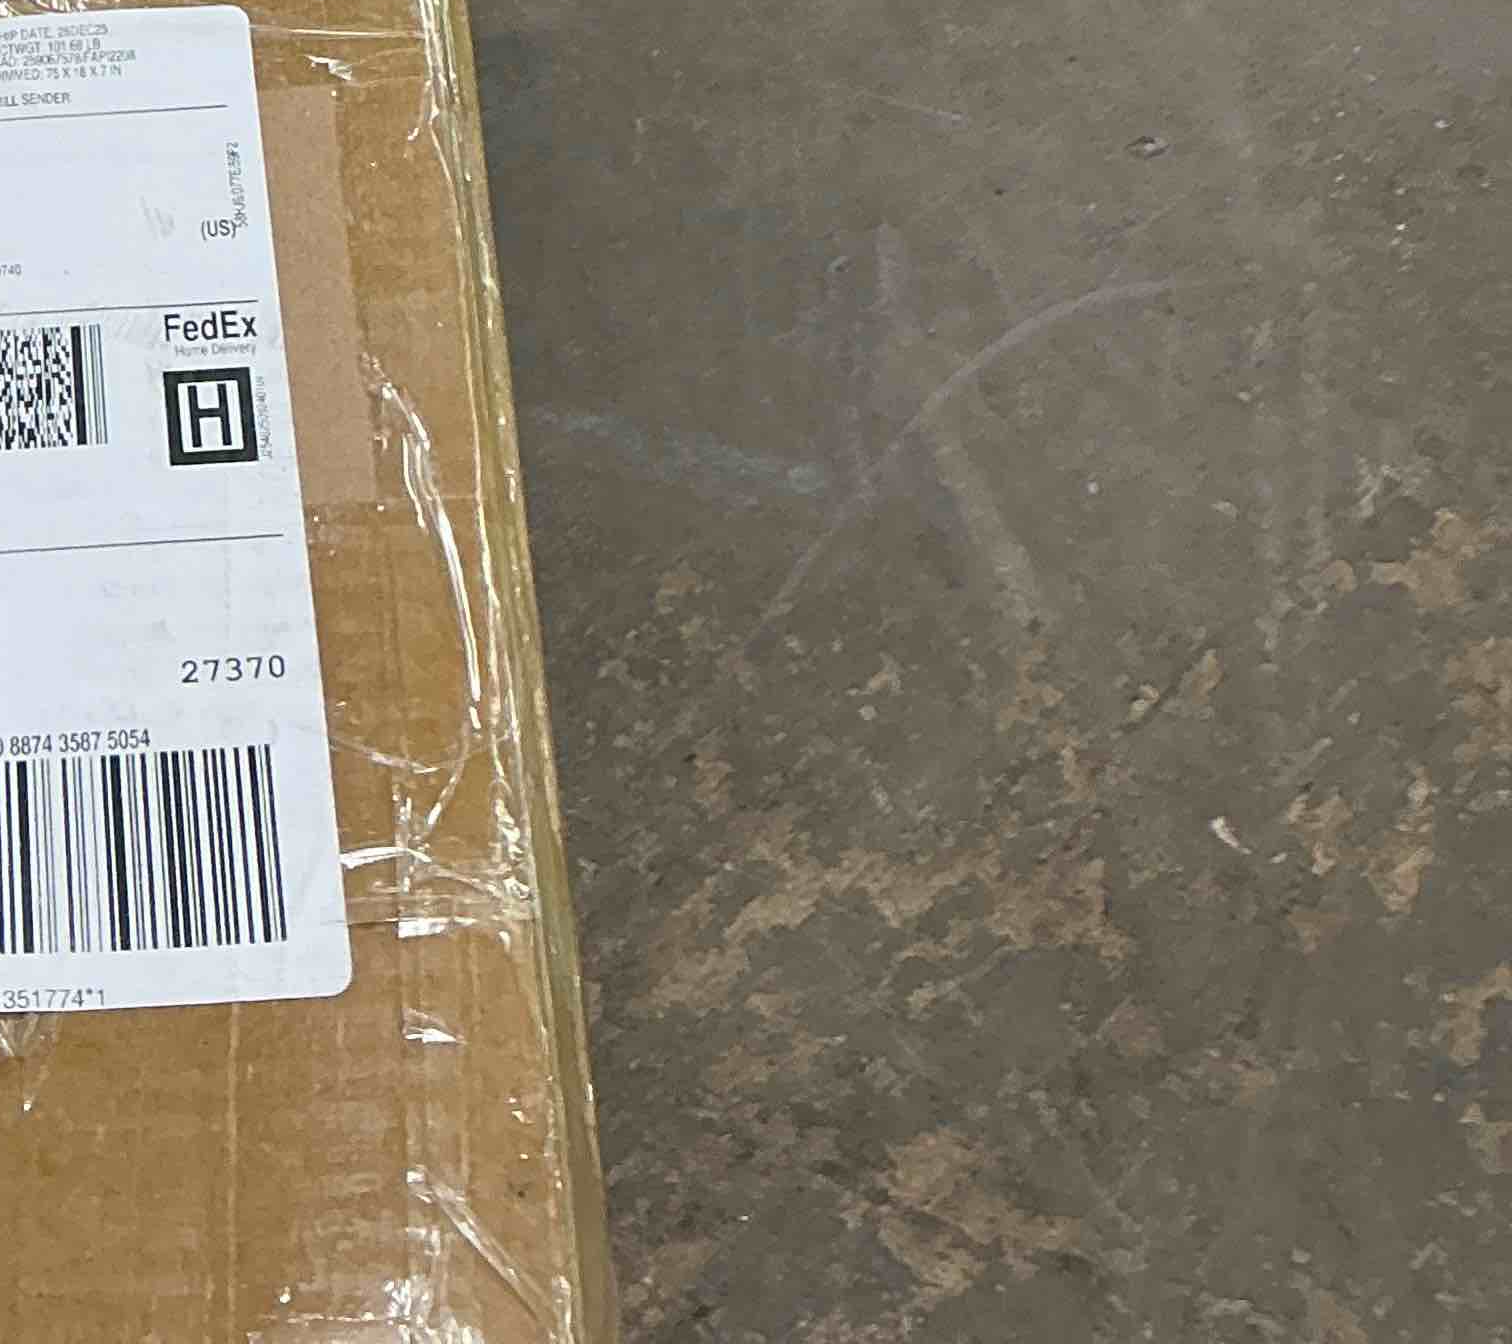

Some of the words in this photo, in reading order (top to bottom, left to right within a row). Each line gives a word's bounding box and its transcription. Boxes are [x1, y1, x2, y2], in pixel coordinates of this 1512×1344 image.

[21, 92, 71, 105] SENDER
[201, 219, 239, 242] (US)
[164, 310, 257, 342] FedEx
[180, 654, 286, 685] 27370
[10, 734, 53, 756] 8874
[58, 730, 101, 753] 3587
[106, 728, 151, 750] 5054
